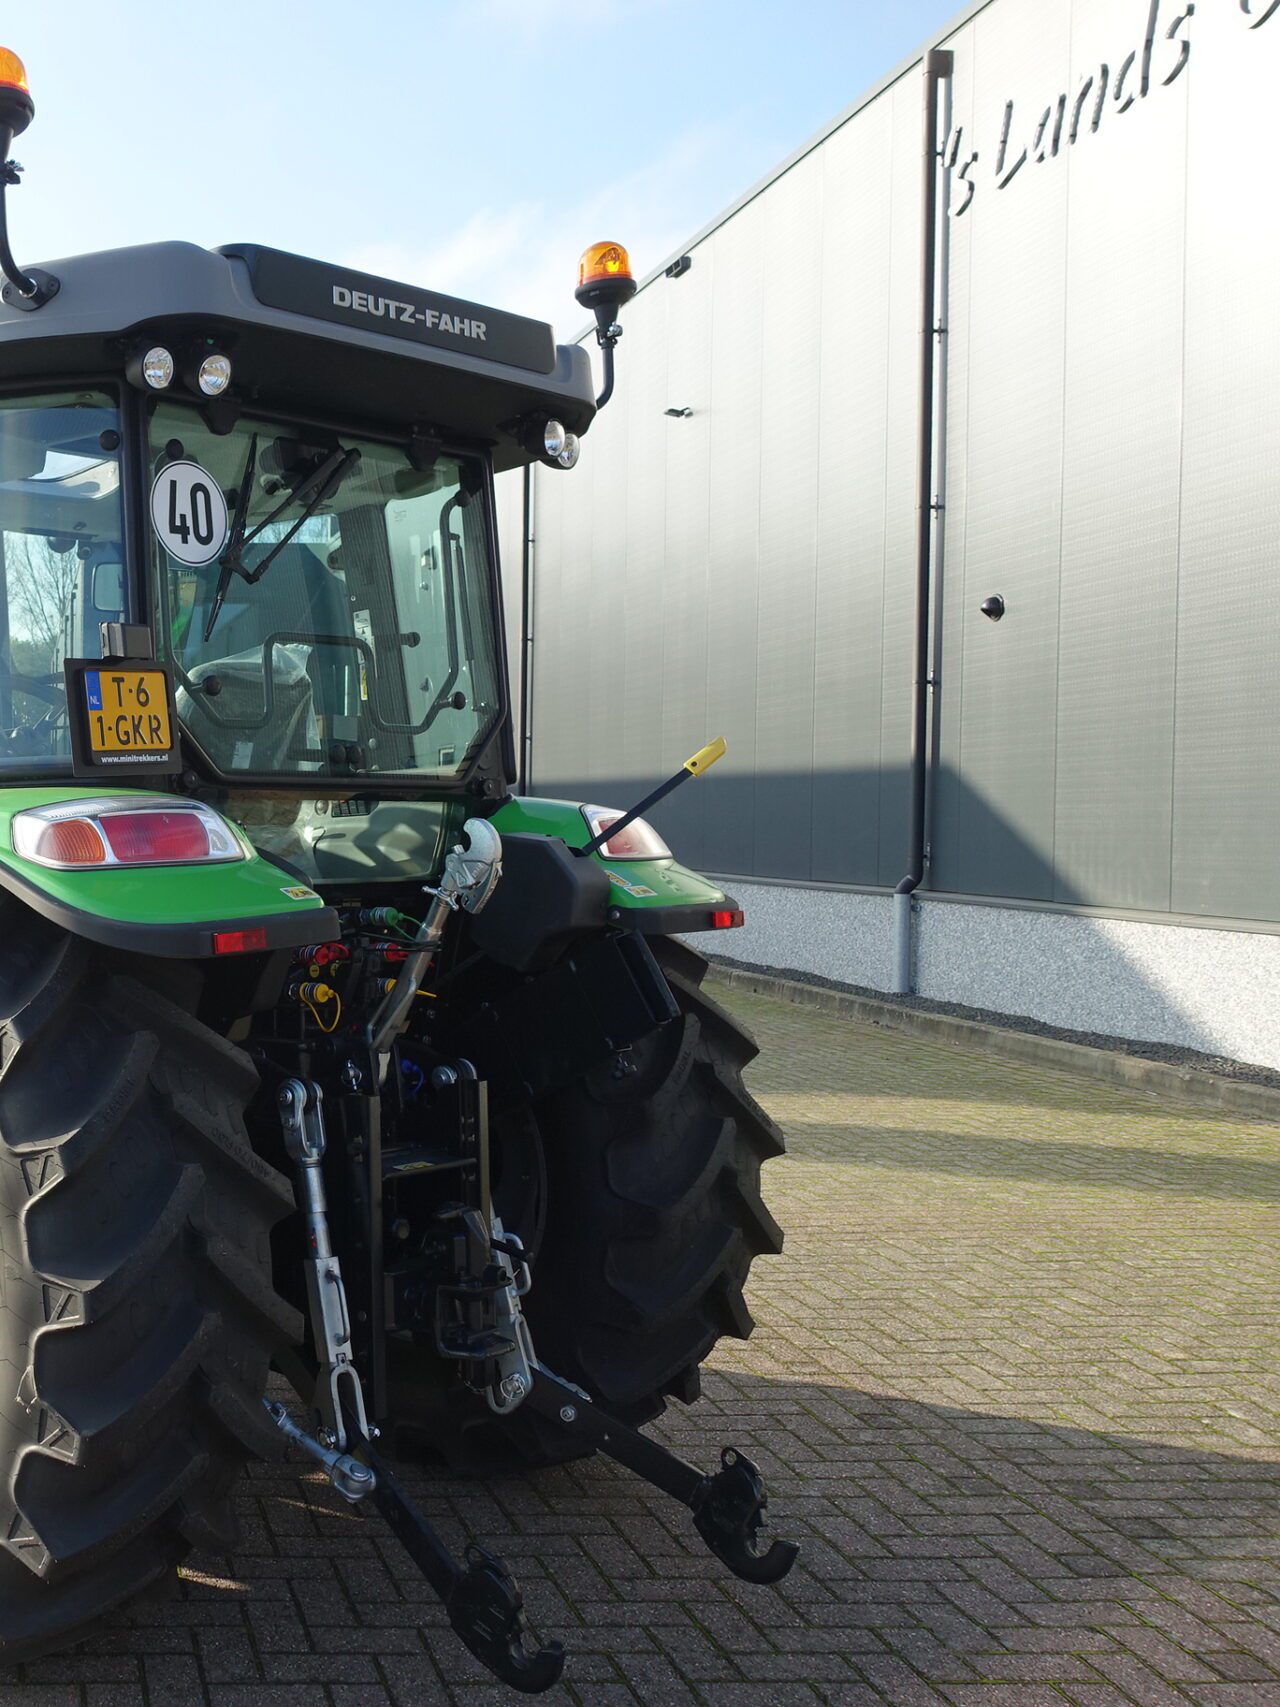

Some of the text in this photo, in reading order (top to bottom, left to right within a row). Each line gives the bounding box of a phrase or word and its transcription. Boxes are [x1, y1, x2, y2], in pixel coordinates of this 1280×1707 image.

[995, 0, 1195, 190] Lands
[332, 284, 487, 341] DEUTZ-FAHR
[168, 479, 214, 546] 40
[90, 695, 100, 705] NL
[101, 753, 168, 763] www.minitrekkers.nl
